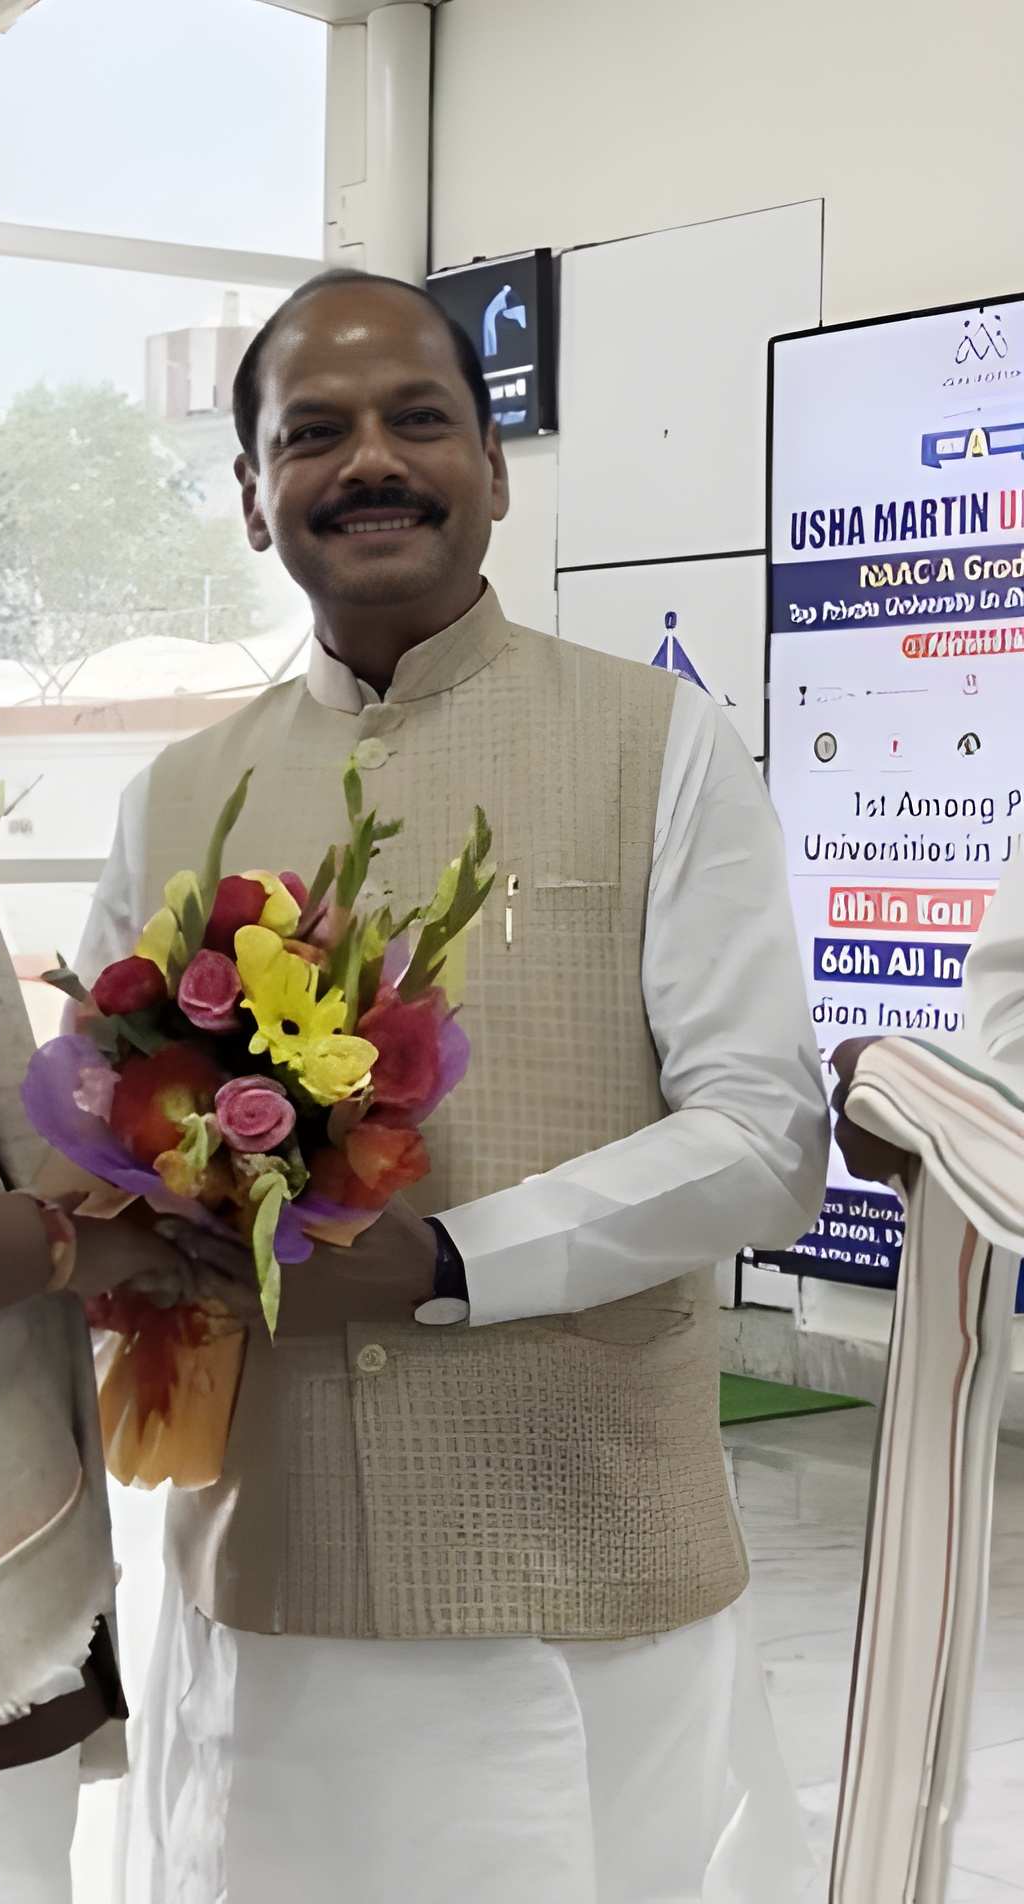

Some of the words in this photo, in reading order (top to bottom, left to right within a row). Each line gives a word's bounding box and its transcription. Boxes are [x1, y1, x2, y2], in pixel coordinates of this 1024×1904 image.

[790, 505, 865, 550] USHA
[874, 492, 989, 543] MARTIN
[896, 791, 995, 825] Among
[966, 833, 990, 862] in
[821, 945, 880, 975] 66th
[887, 947, 925, 976] All
